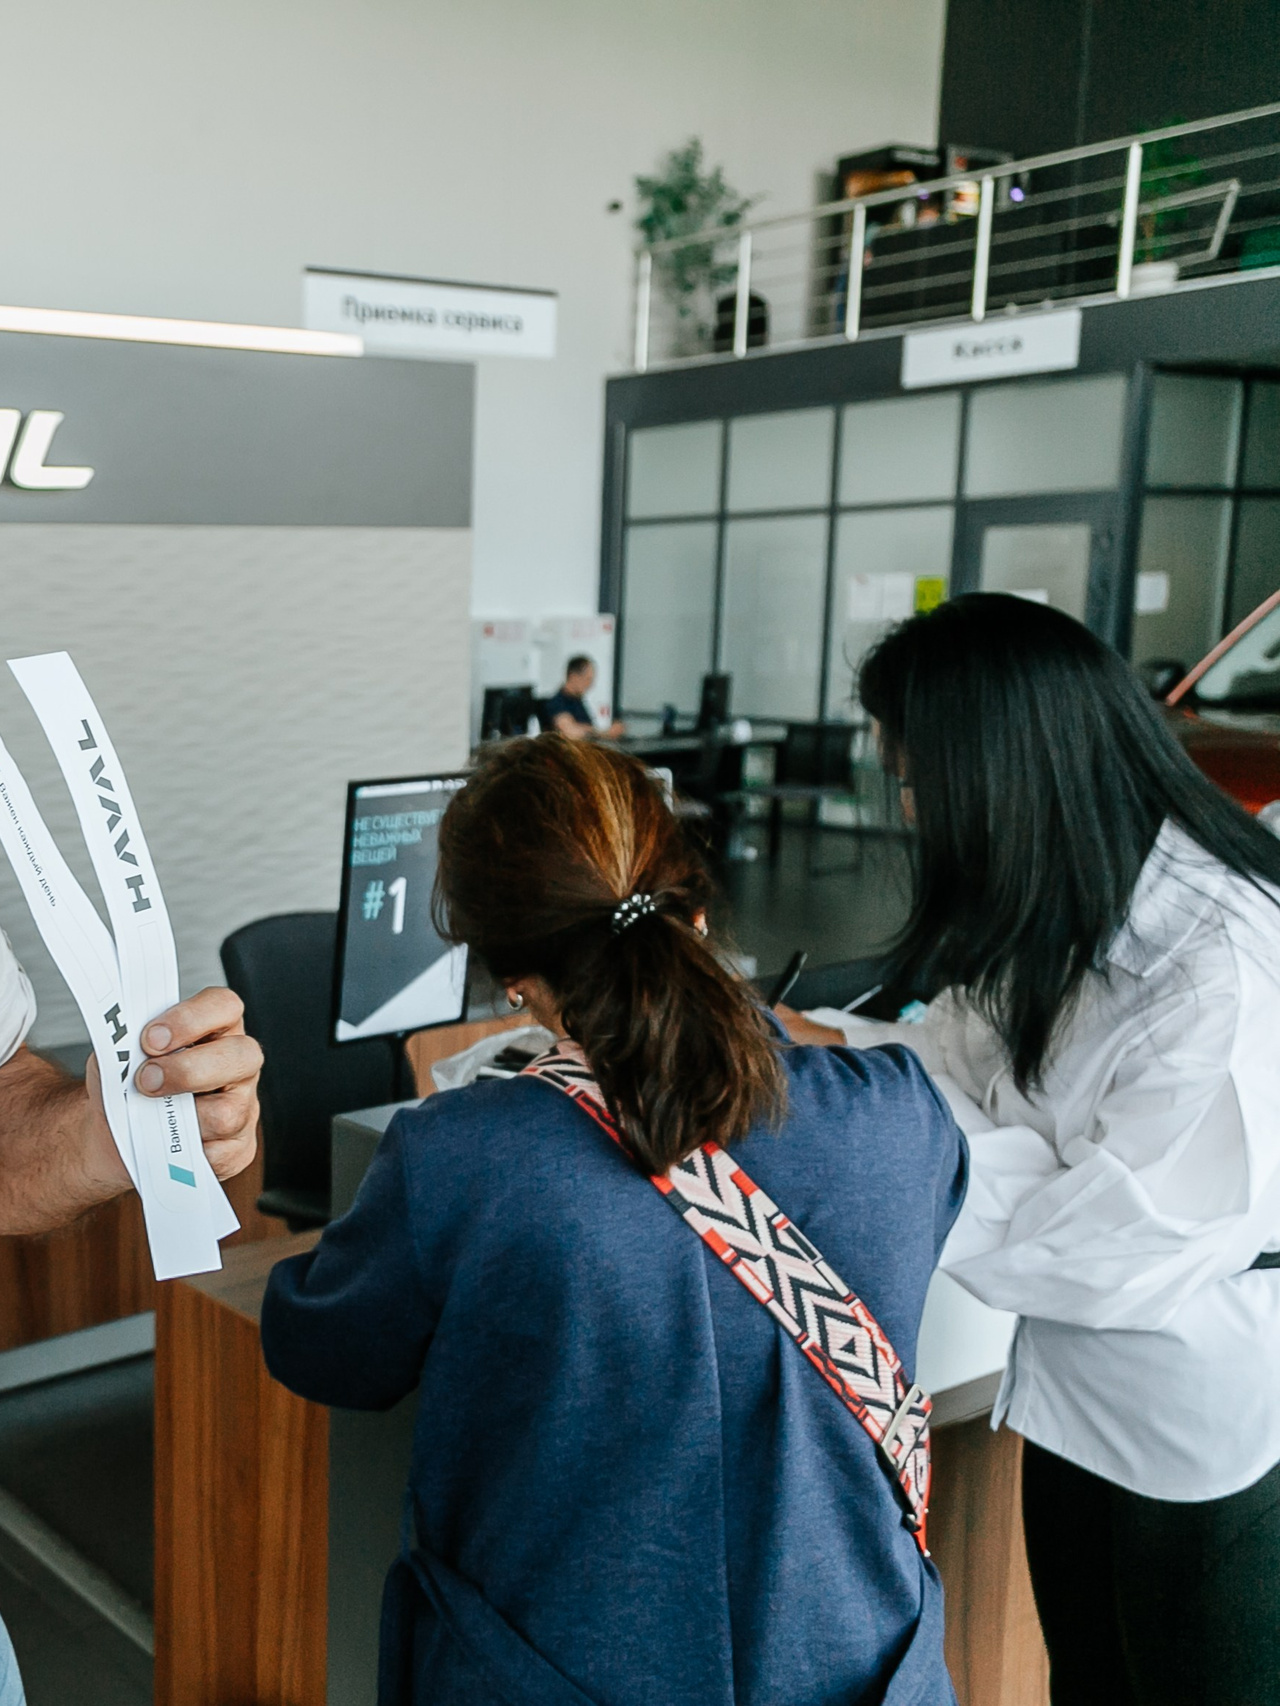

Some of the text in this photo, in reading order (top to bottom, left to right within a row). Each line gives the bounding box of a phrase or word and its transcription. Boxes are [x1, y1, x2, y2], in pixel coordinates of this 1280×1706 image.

[442, 308, 523, 332] сервиса
[953, 336, 1023, 359] Касса
[78, 719, 152, 913] HAVAL
[17, 826, 43, 876] каждый
[39, 878, 56, 907] день
[362, 876, 408, 935] #1
[166, 1110, 183, 1154] Важен
